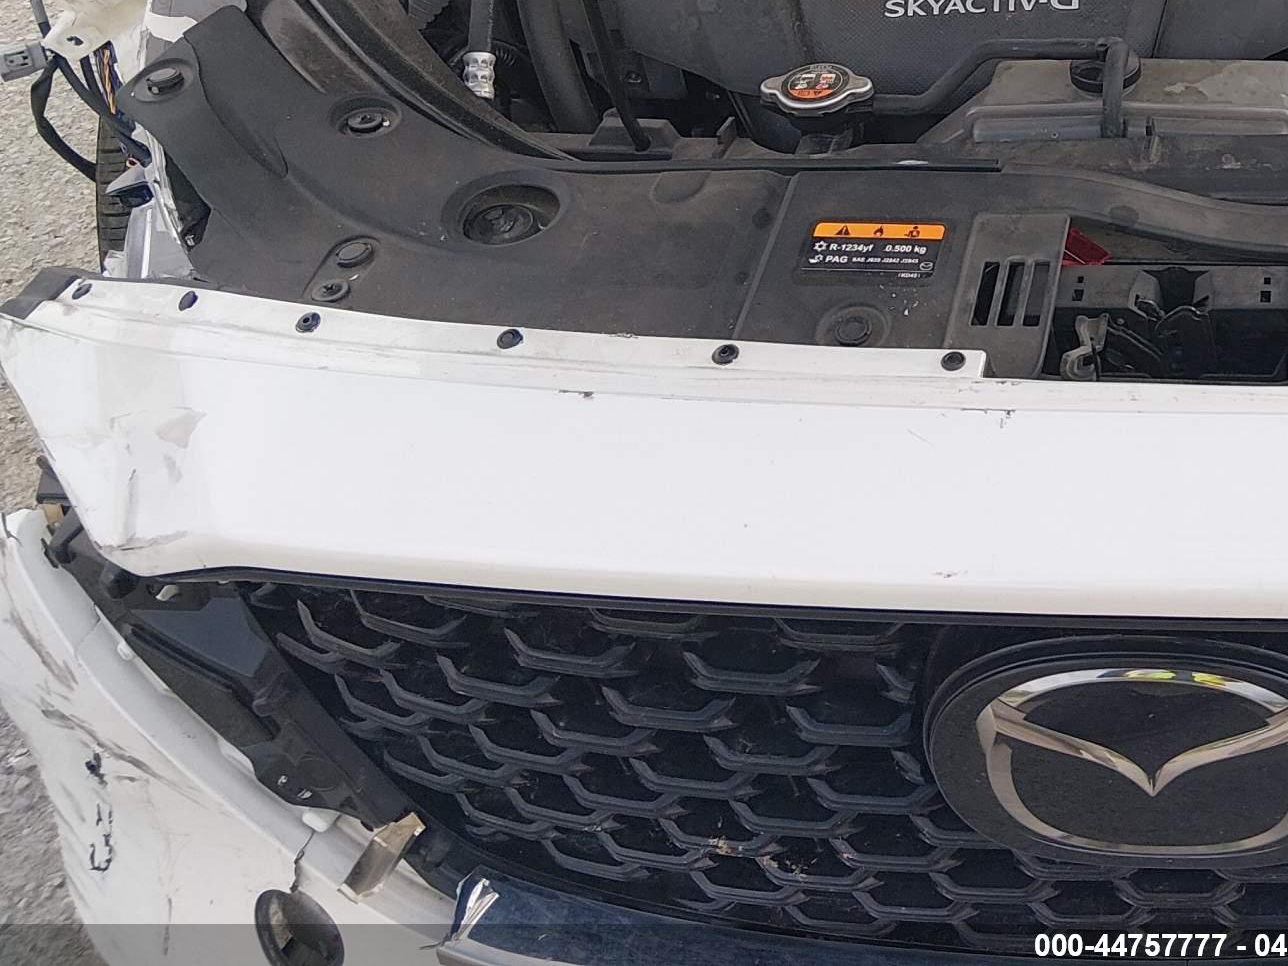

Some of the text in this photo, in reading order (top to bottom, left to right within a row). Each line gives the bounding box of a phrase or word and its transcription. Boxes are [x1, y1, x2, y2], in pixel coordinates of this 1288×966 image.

[829, 243, 927, 254] R-1234yf 0.500 kg
[825, 255, 848, 263] PAG
